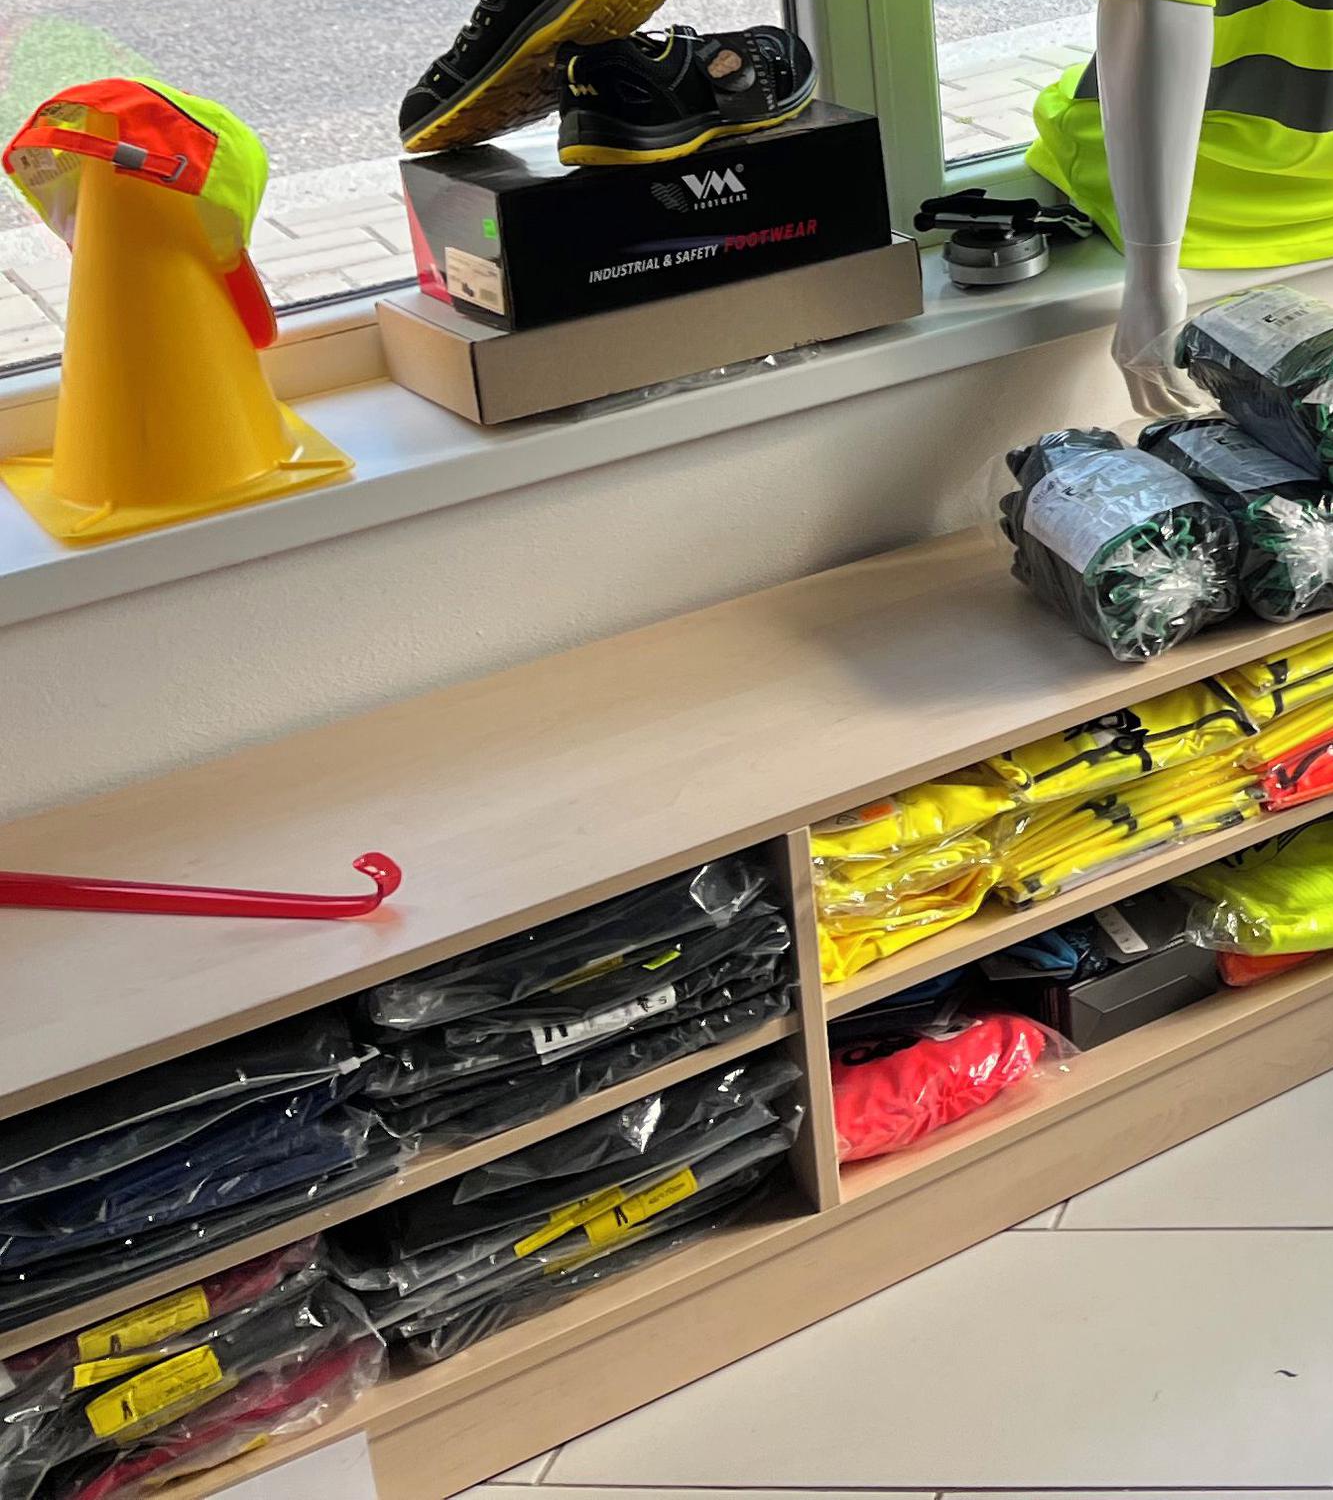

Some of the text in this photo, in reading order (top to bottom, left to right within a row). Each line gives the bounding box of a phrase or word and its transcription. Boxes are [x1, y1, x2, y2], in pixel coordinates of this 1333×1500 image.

[681, 167, 747, 199] VM
[693, 193, 749, 211] FOOTWEAR
[588, 220, 818, 284] INDUSTRIAL & SAFETY FOOTWEAR
